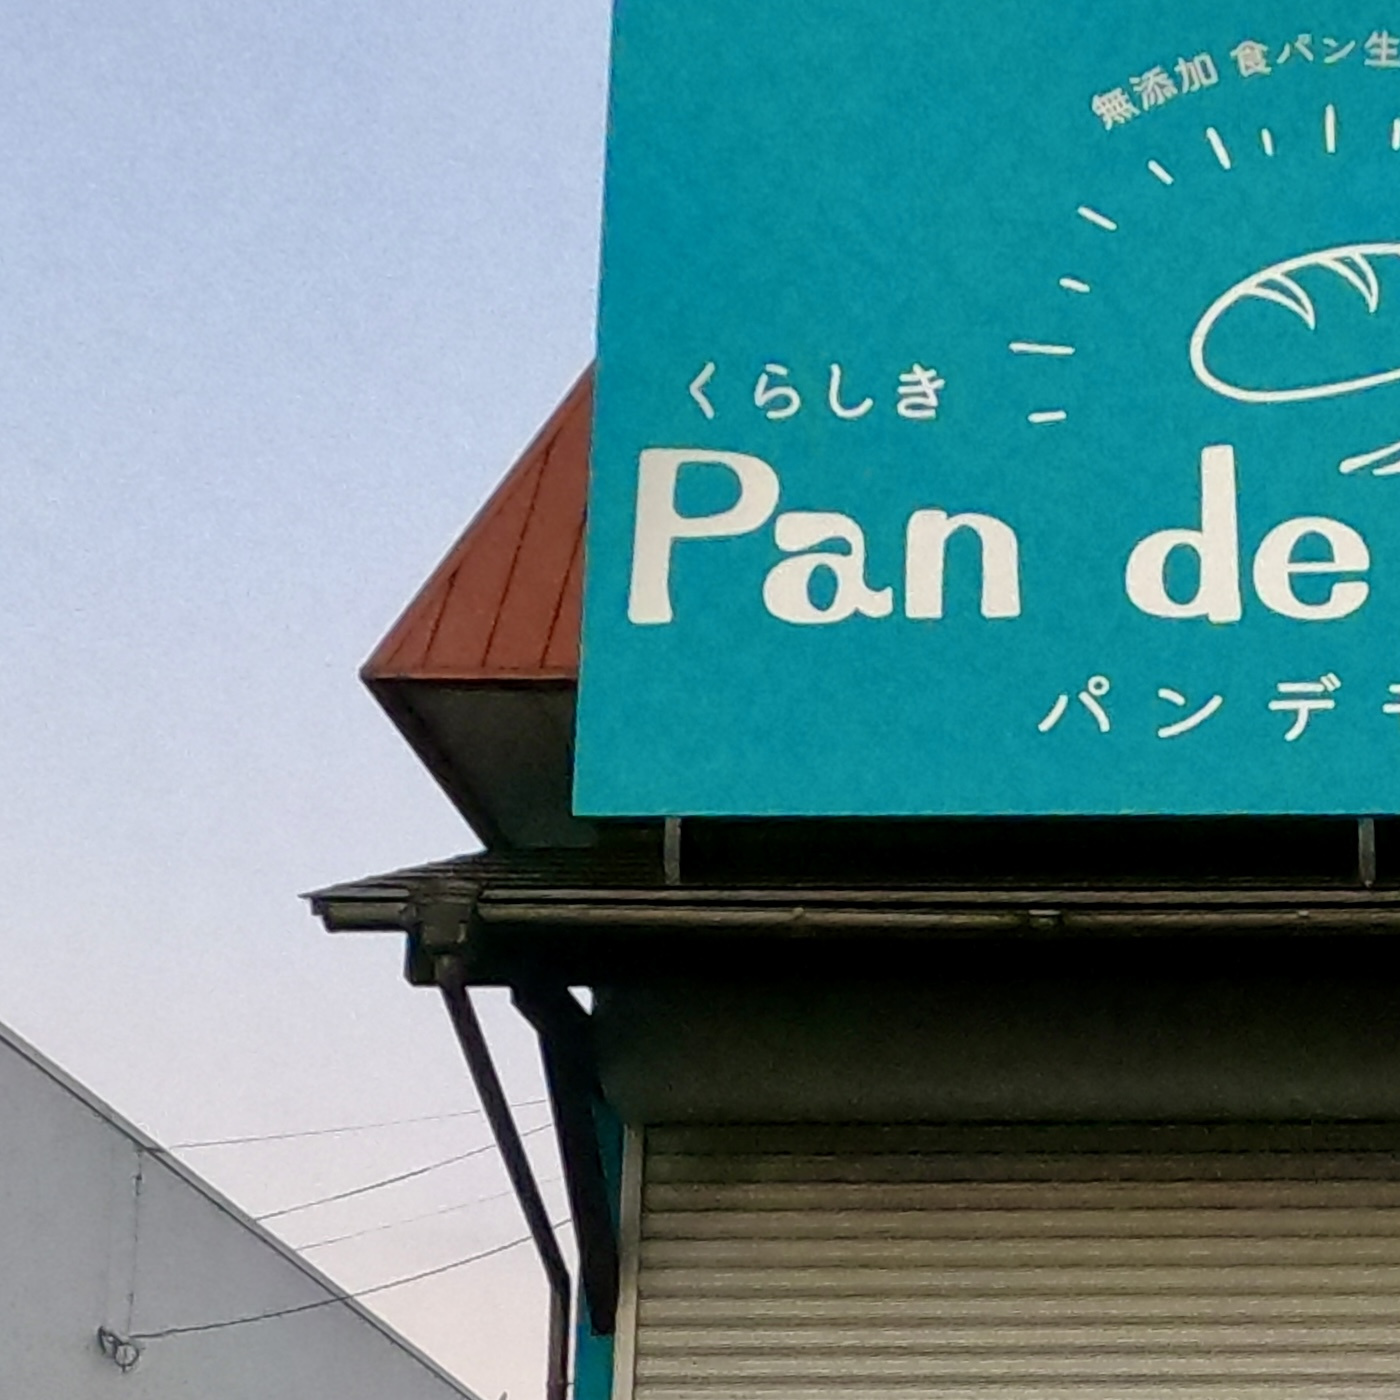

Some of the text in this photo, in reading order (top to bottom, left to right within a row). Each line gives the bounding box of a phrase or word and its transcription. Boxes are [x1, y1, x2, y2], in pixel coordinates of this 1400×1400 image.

[687, 361, 945, 421] くらしき
[627, 446, 1022, 625] Pan
[1125, 443, 1371, 624] de
